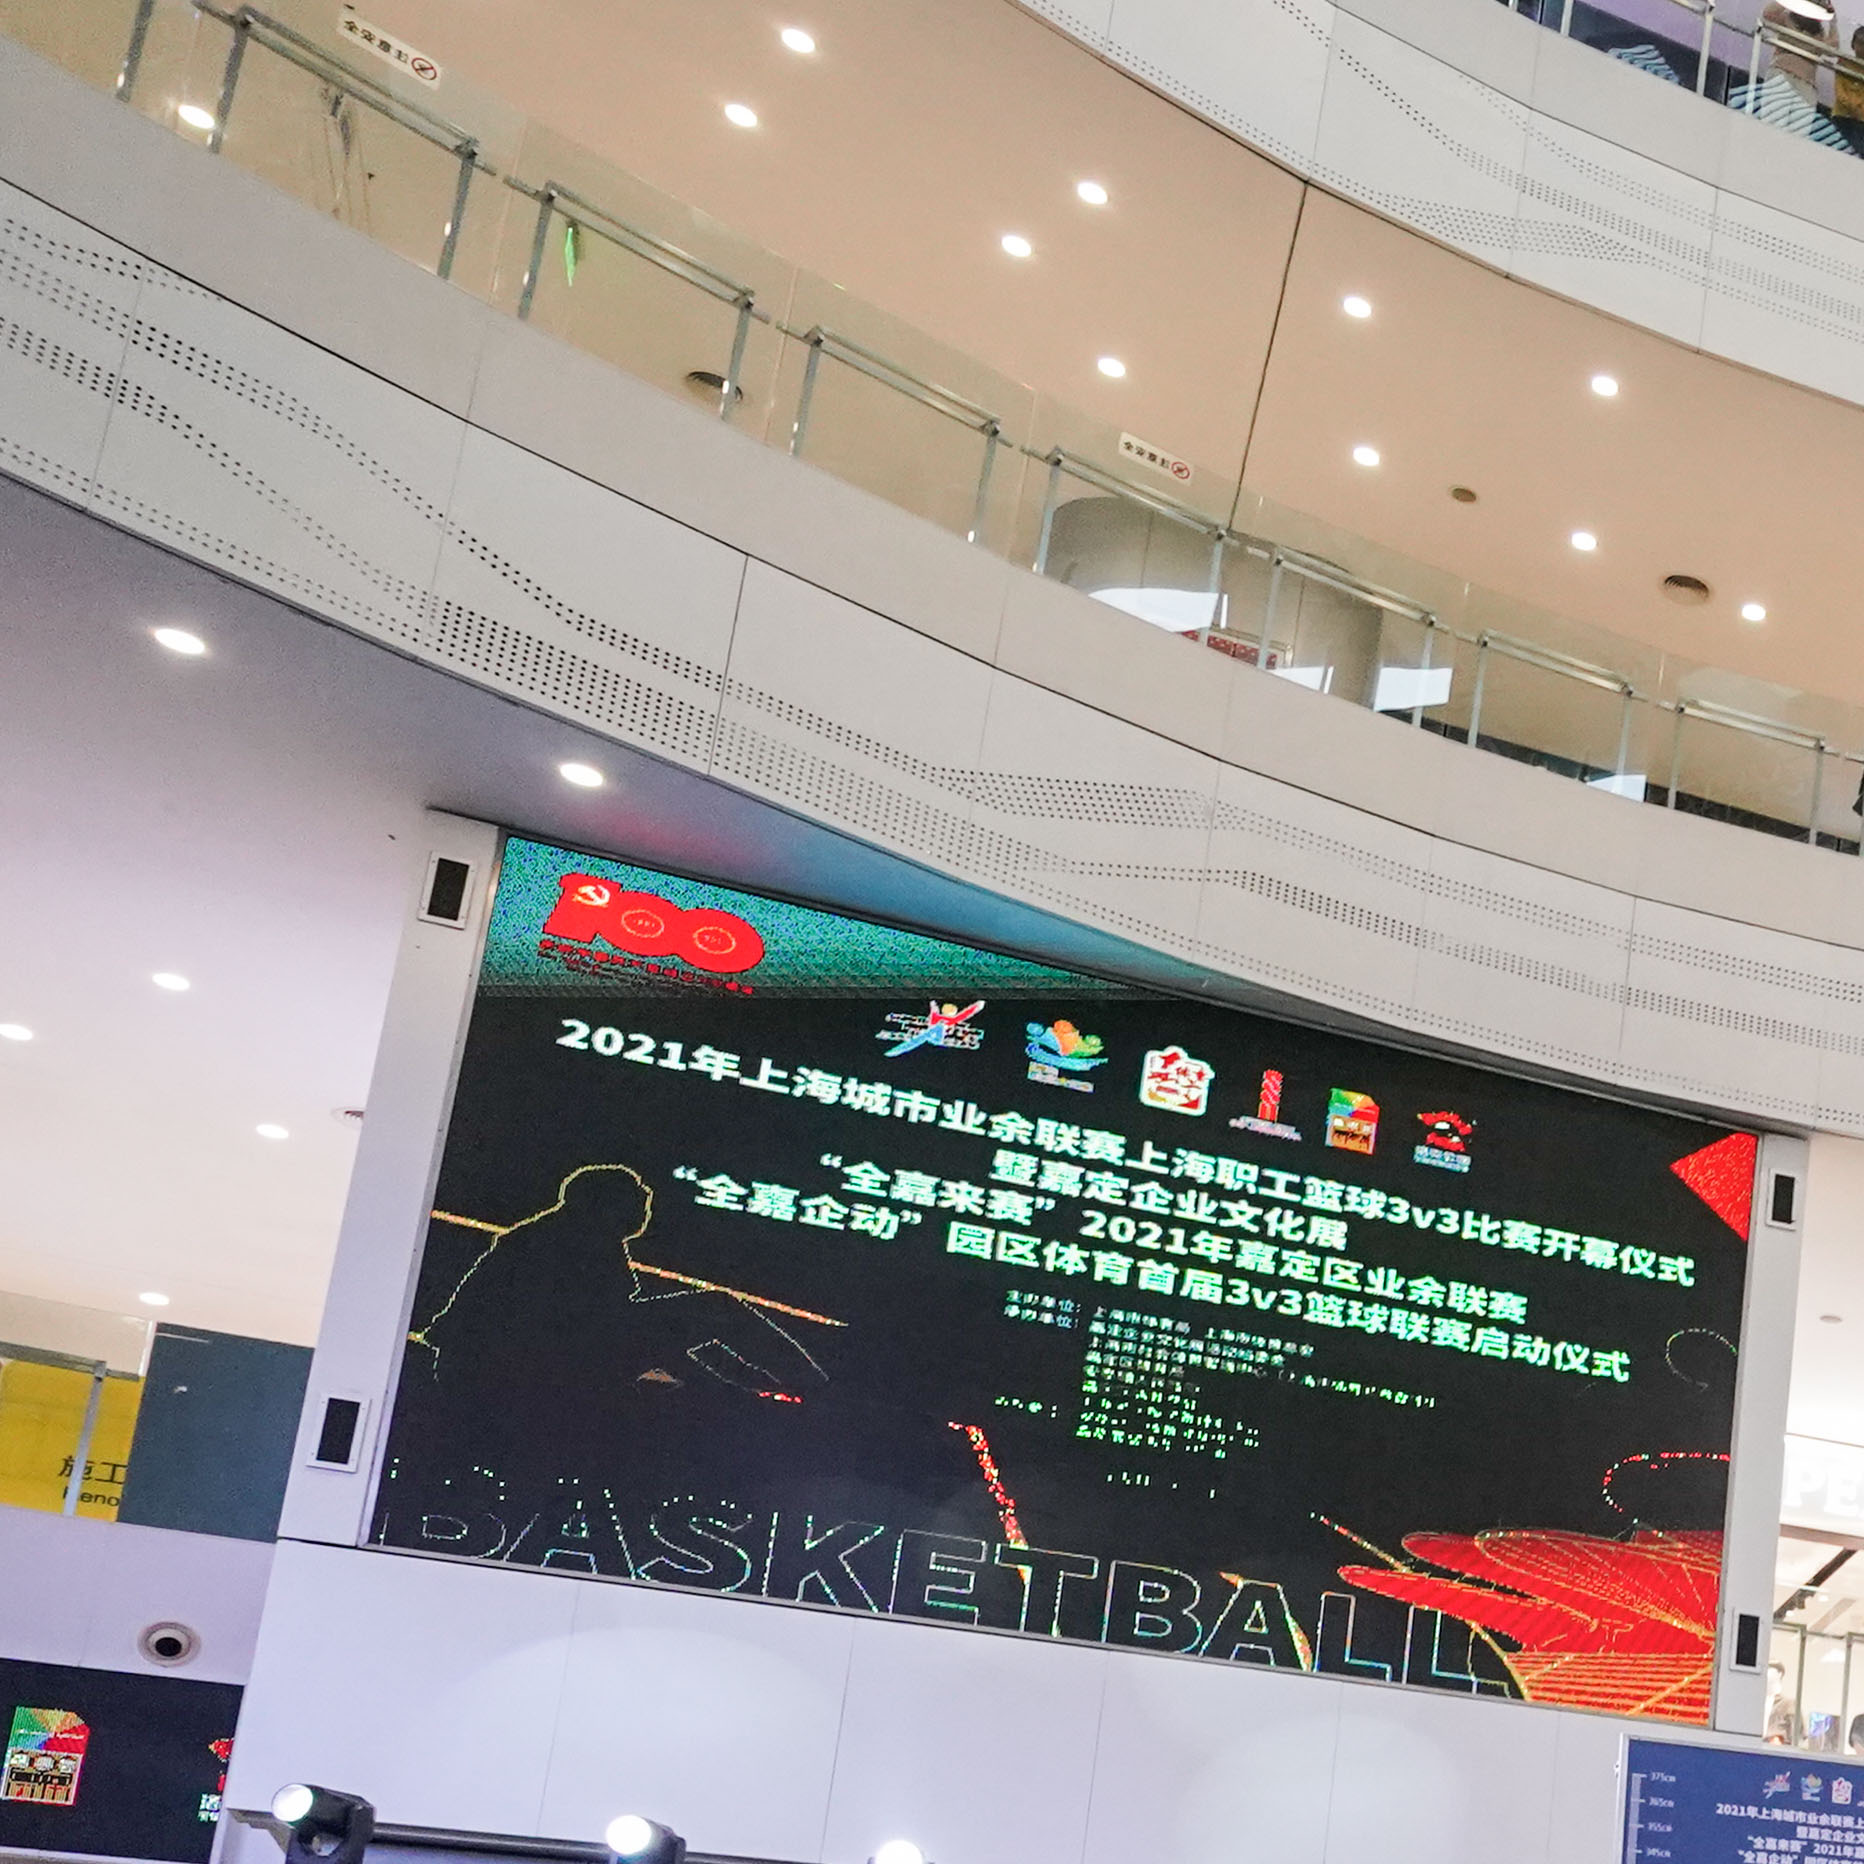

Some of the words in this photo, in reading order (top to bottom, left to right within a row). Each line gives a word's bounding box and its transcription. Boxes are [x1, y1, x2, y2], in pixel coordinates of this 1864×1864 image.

[555, 1018, 1697, 1287] 2021年上海城市业余联赛上海职工篮球3v3比赛开幕仪式
[990, 1147, 1349, 1252] 暨嘉定企业文化展
[945, 1221, 1632, 1383] 园区体育首届3v3篮球联赛启动仪式
[1080, 1207, 1530, 1326] 2021年嘉定区业余联赛
